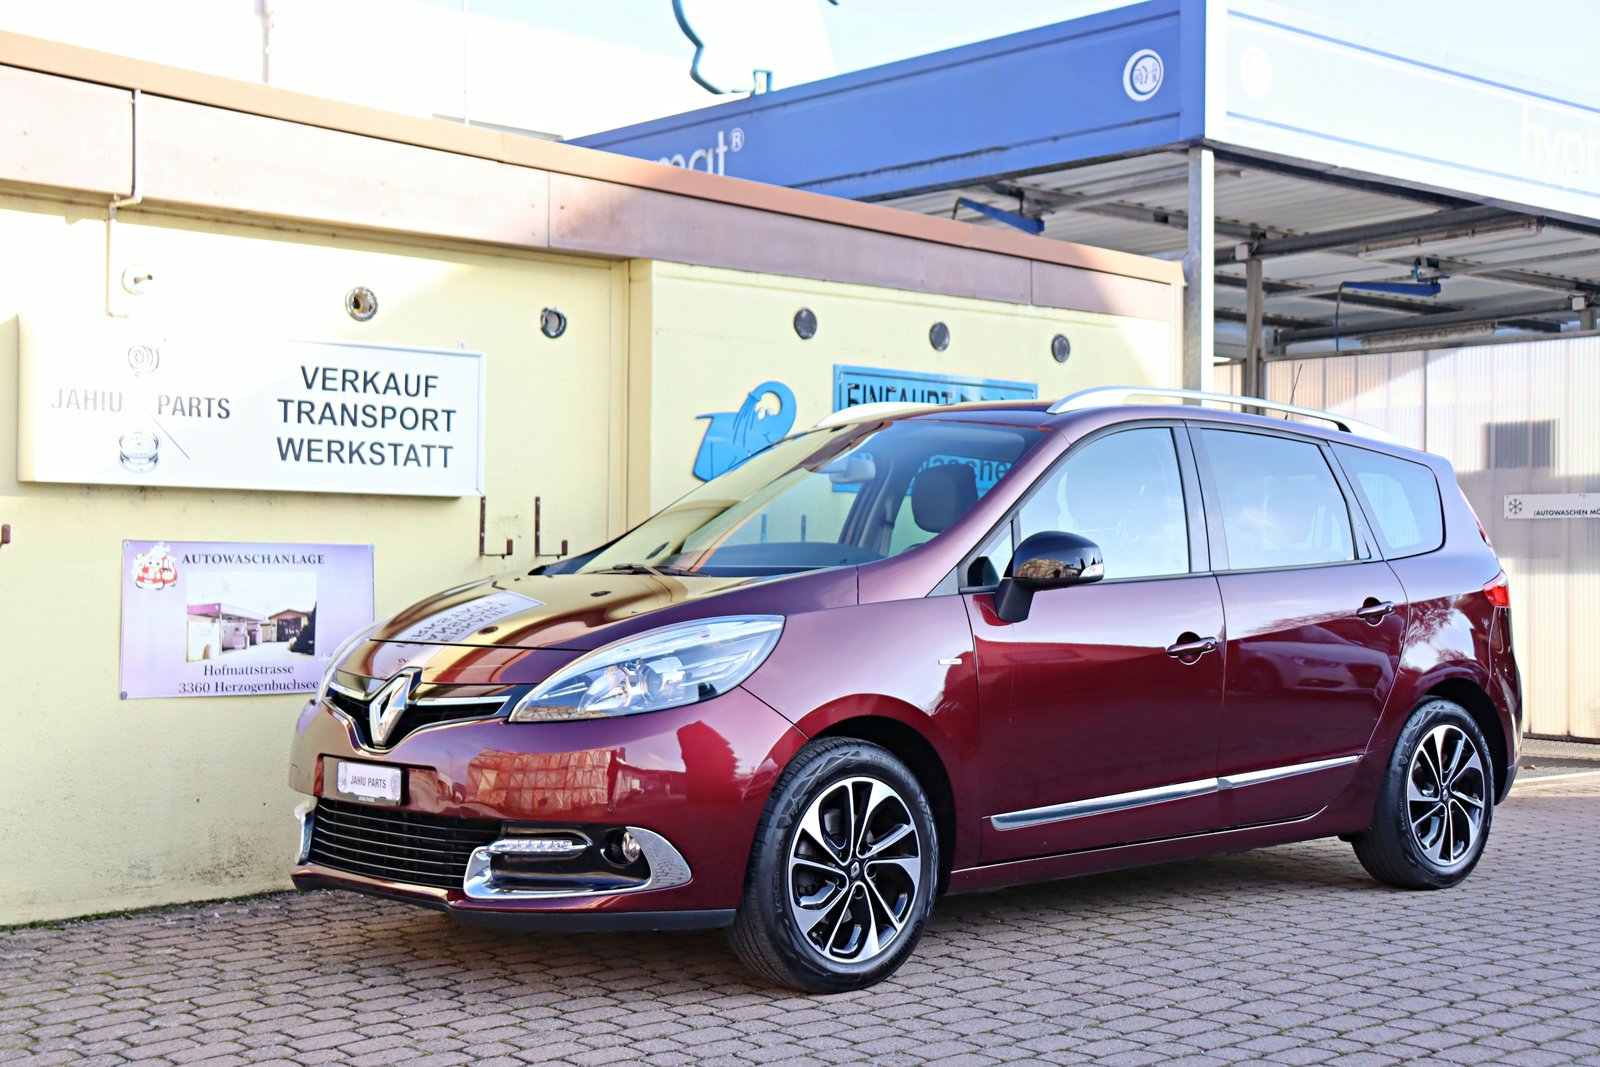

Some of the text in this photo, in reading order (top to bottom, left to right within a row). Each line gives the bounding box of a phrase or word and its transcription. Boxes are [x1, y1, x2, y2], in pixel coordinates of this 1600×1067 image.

[300, 364, 439, 398] VERKAUF
[51, 388, 231, 420] JAHIU PARTS
[277, 398, 456, 433] TRANSPORT
[276, 436, 454, 469] WERKSTATT
[182, 553, 325, 565] AUTOWASCHANLAGE
[203, 664, 294, 677] Hofmattstrasse
[179, 679, 319, 694] 3360 Herzogenbuchsee
[368, 777, 387, 789] PARTS
